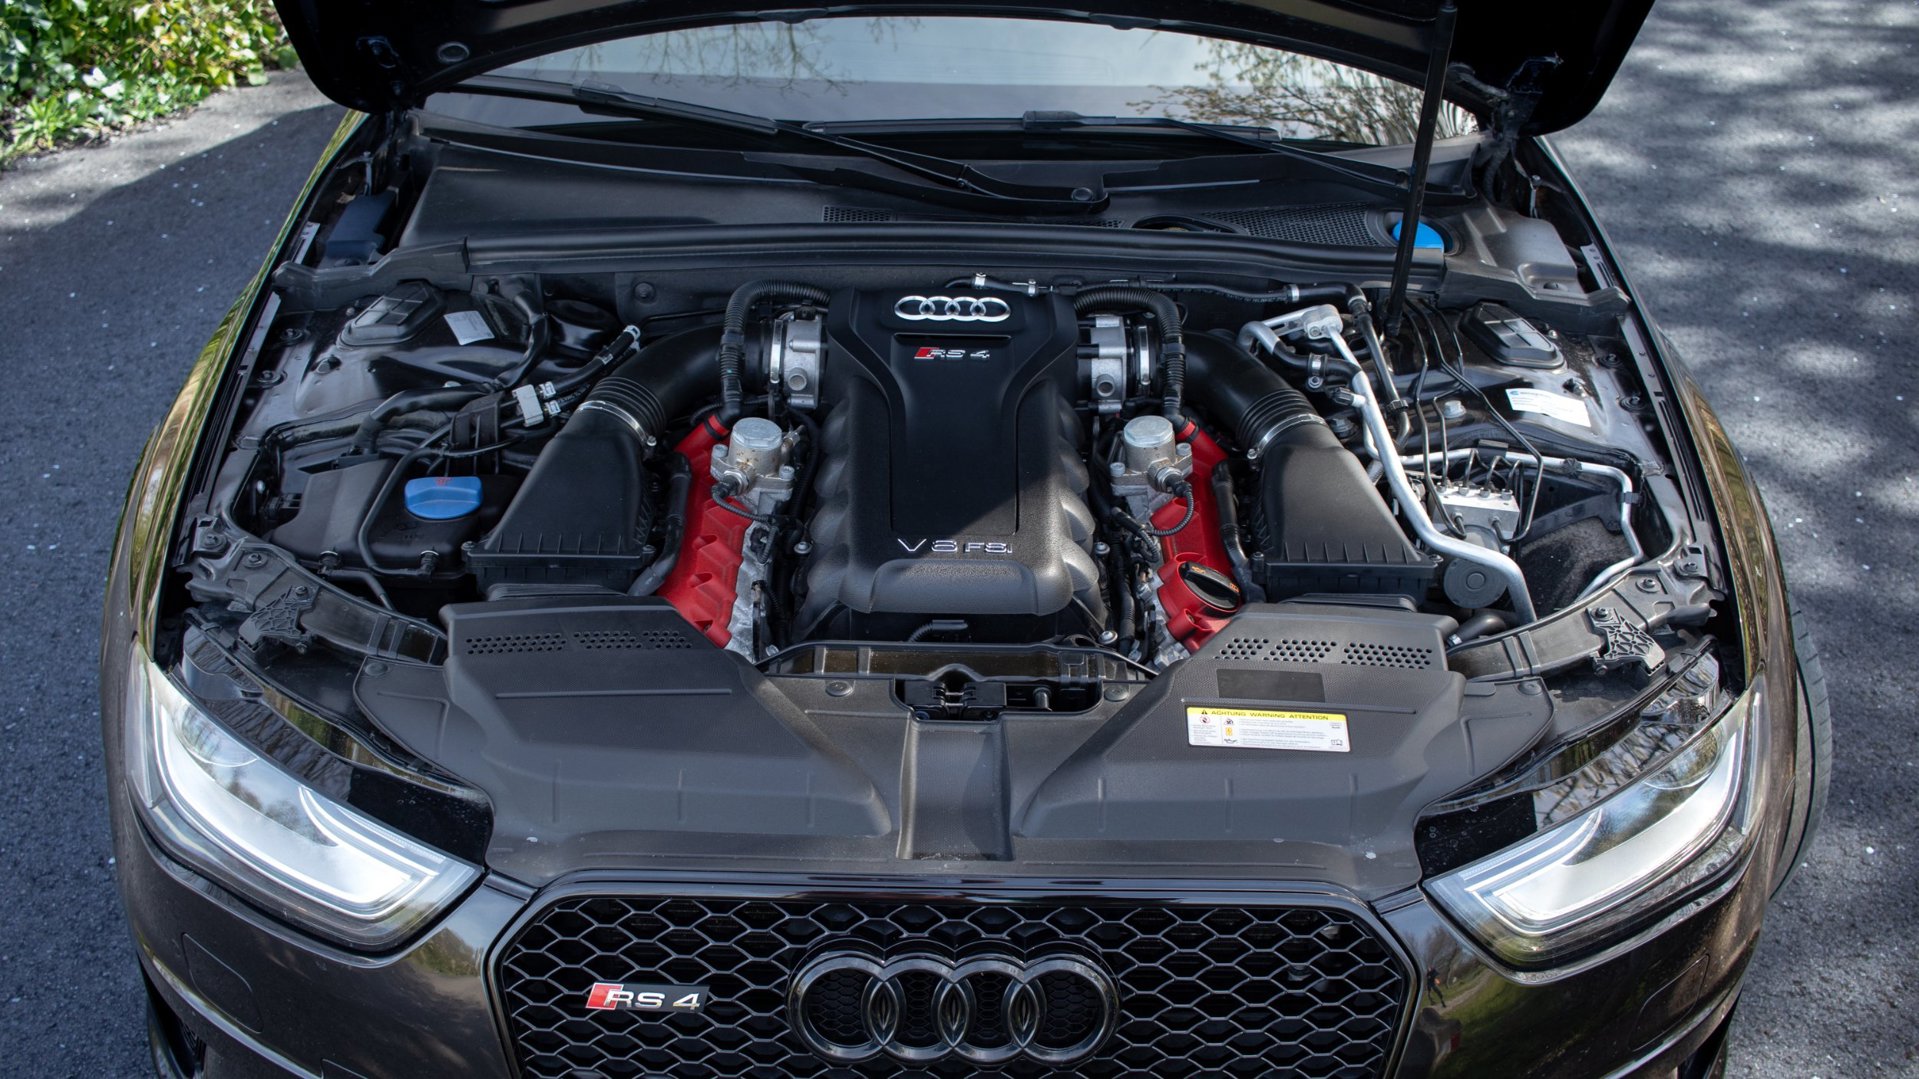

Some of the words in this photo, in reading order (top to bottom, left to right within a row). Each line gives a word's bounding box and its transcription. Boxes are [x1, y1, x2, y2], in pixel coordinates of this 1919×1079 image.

[924, 348, 966, 359] RS
[970, 349, 990, 359] 4
[603, 989, 666, 1008] RS
[672, 992, 701, 1010] 4
